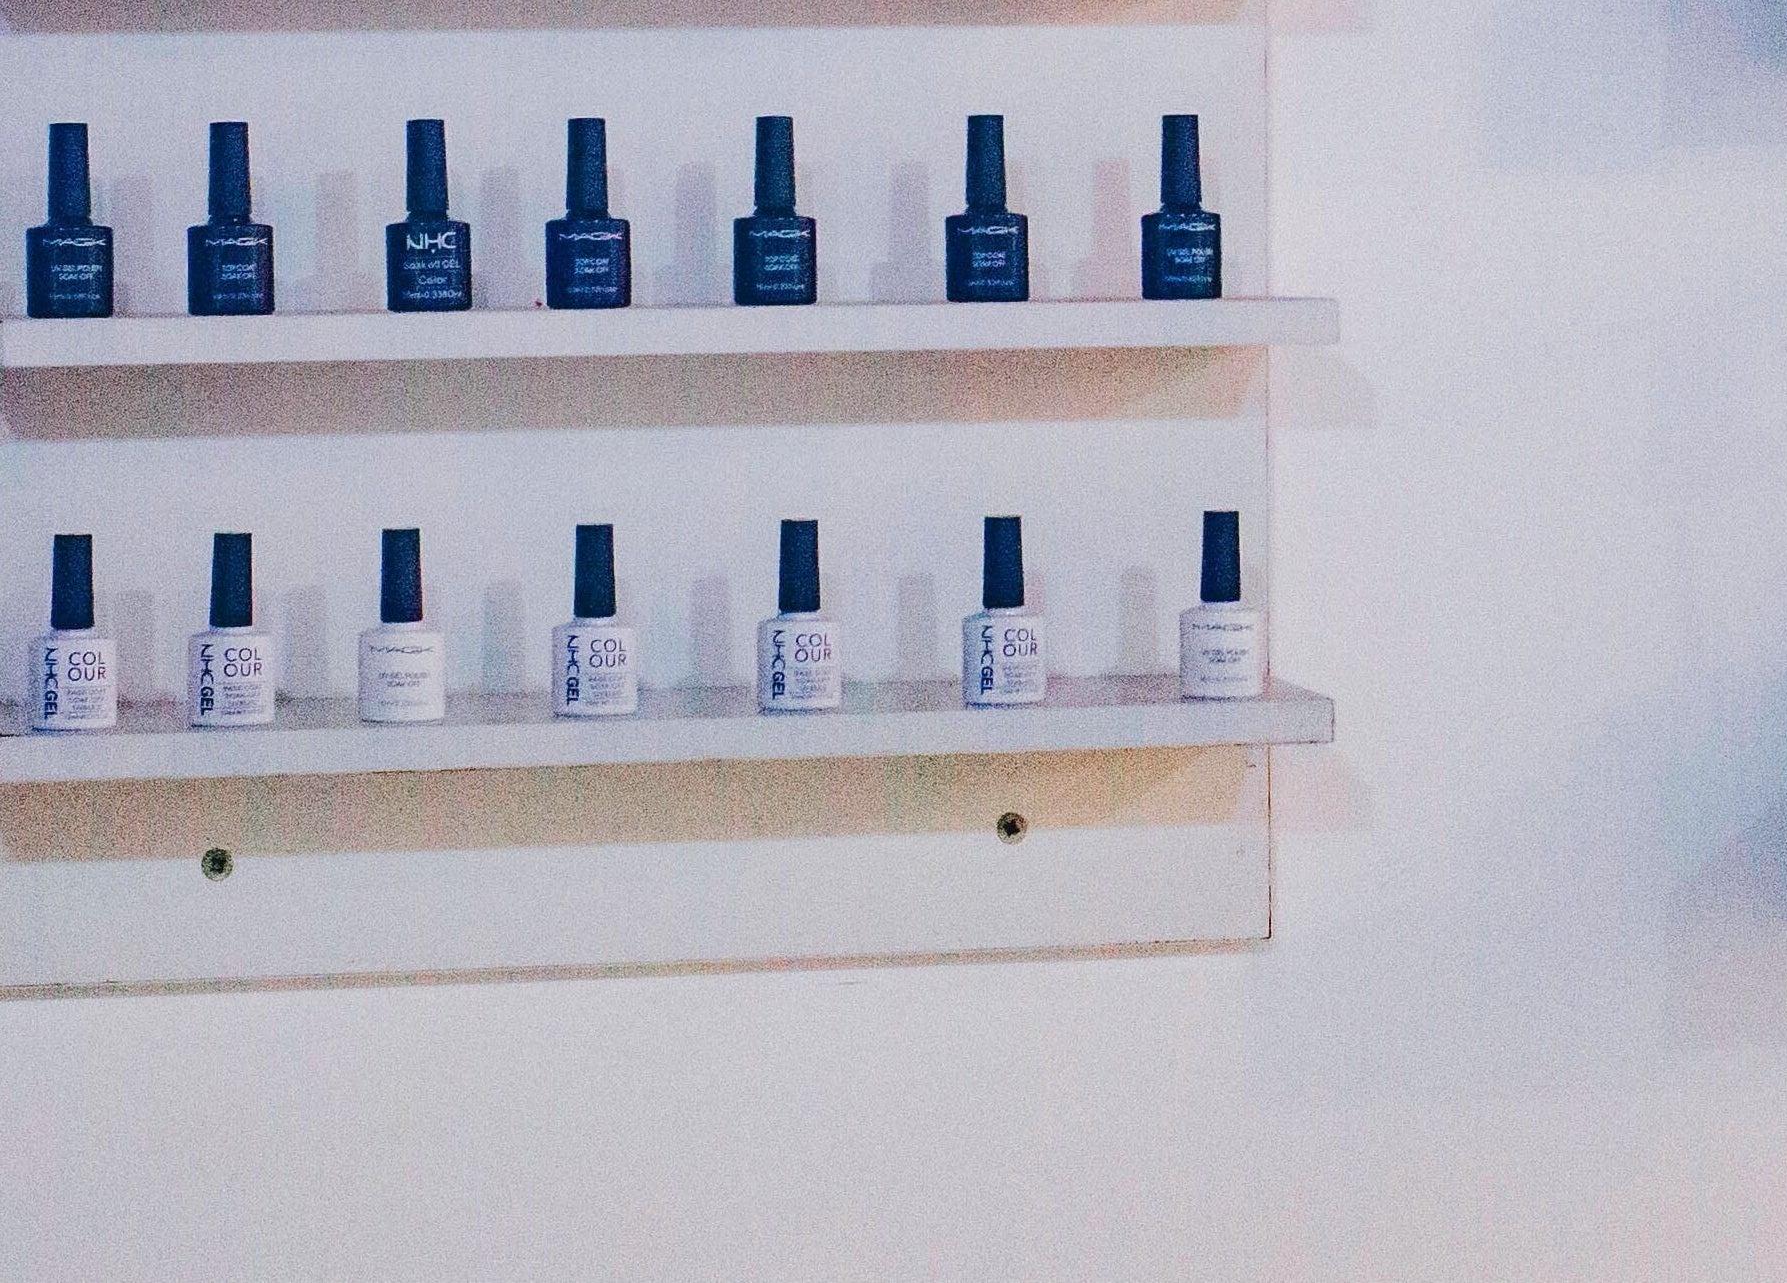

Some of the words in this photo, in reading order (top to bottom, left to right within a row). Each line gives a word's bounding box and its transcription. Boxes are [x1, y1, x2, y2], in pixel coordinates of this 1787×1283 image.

[406, 231, 457, 250] NHC
[796, 633, 831, 647] COL
[1004, 628, 1036, 642] COL
[224, 647, 262, 662] COL
[590, 639, 626, 653] COL
[772, 630, 785, 670] NHC
[981, 625, 994, 665] NHC
[1003, 642, 1037, 656] OUR
[69, 651, 105, 665] COL
[200, 644, 214, 684] NHC
[566, 635, 579, 676] NHC
[589, 654, 627, 668] OUR
[795, 648, 831, 662] OUR
[45, 647, 58, 689] NHC
[68, 667, 106, 681] OUR
[223, 662, 262, 677] OUR
[771, 671, 785, 700] GEL
[981, 666, 994, 695] GEL
[200, 686, 214, 716] GEL
[566, 677, 579, 706] GEL
[44, 691, 58, 719] GEL
